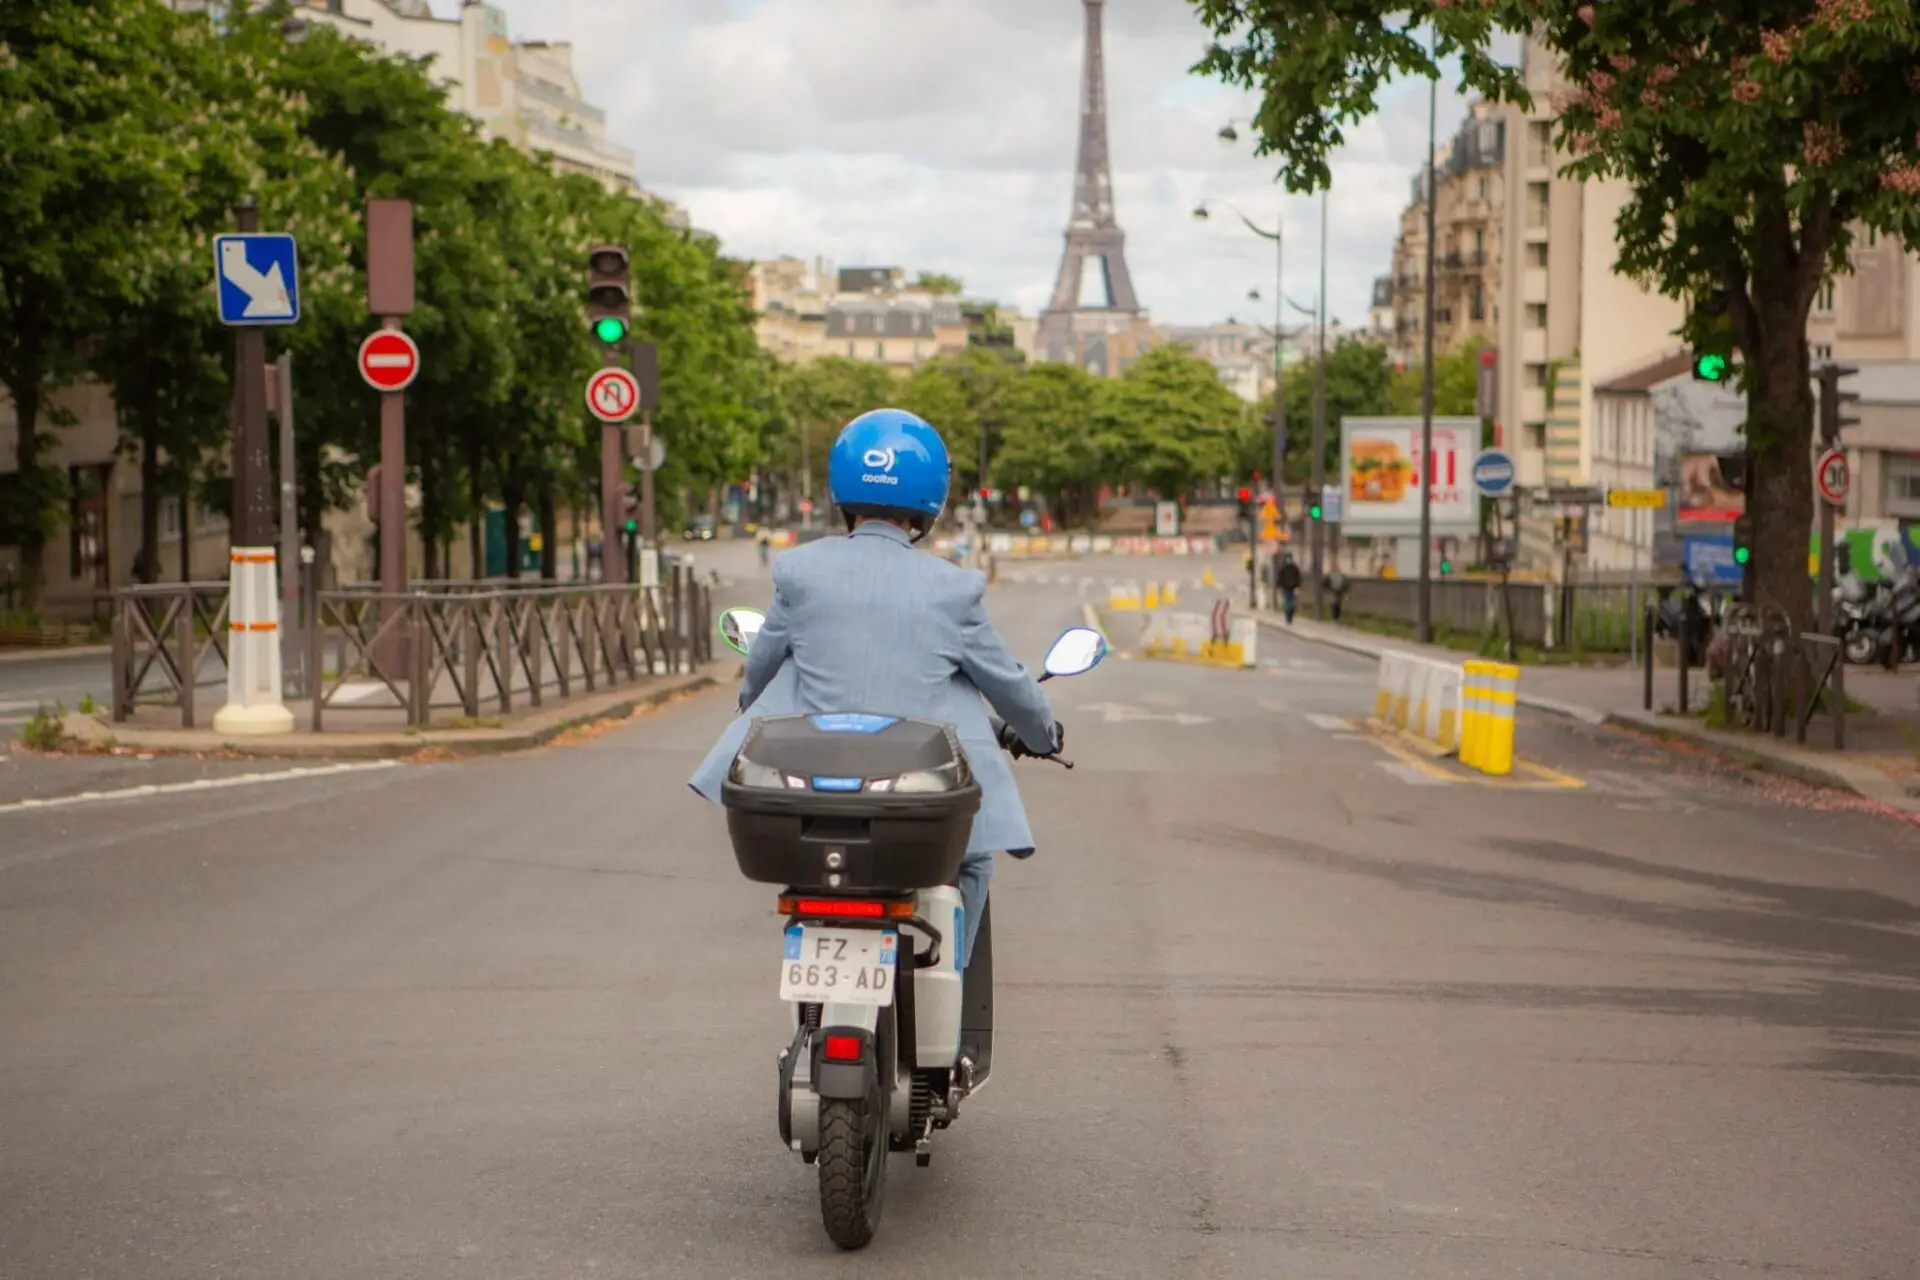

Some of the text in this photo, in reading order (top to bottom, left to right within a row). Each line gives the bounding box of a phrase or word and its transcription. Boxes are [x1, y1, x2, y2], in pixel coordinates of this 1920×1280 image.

[862, 473, 898, 485] cooltra
[1827, 464, 1846, 489] 30
[788, 964, 887, 990] 663-AD
